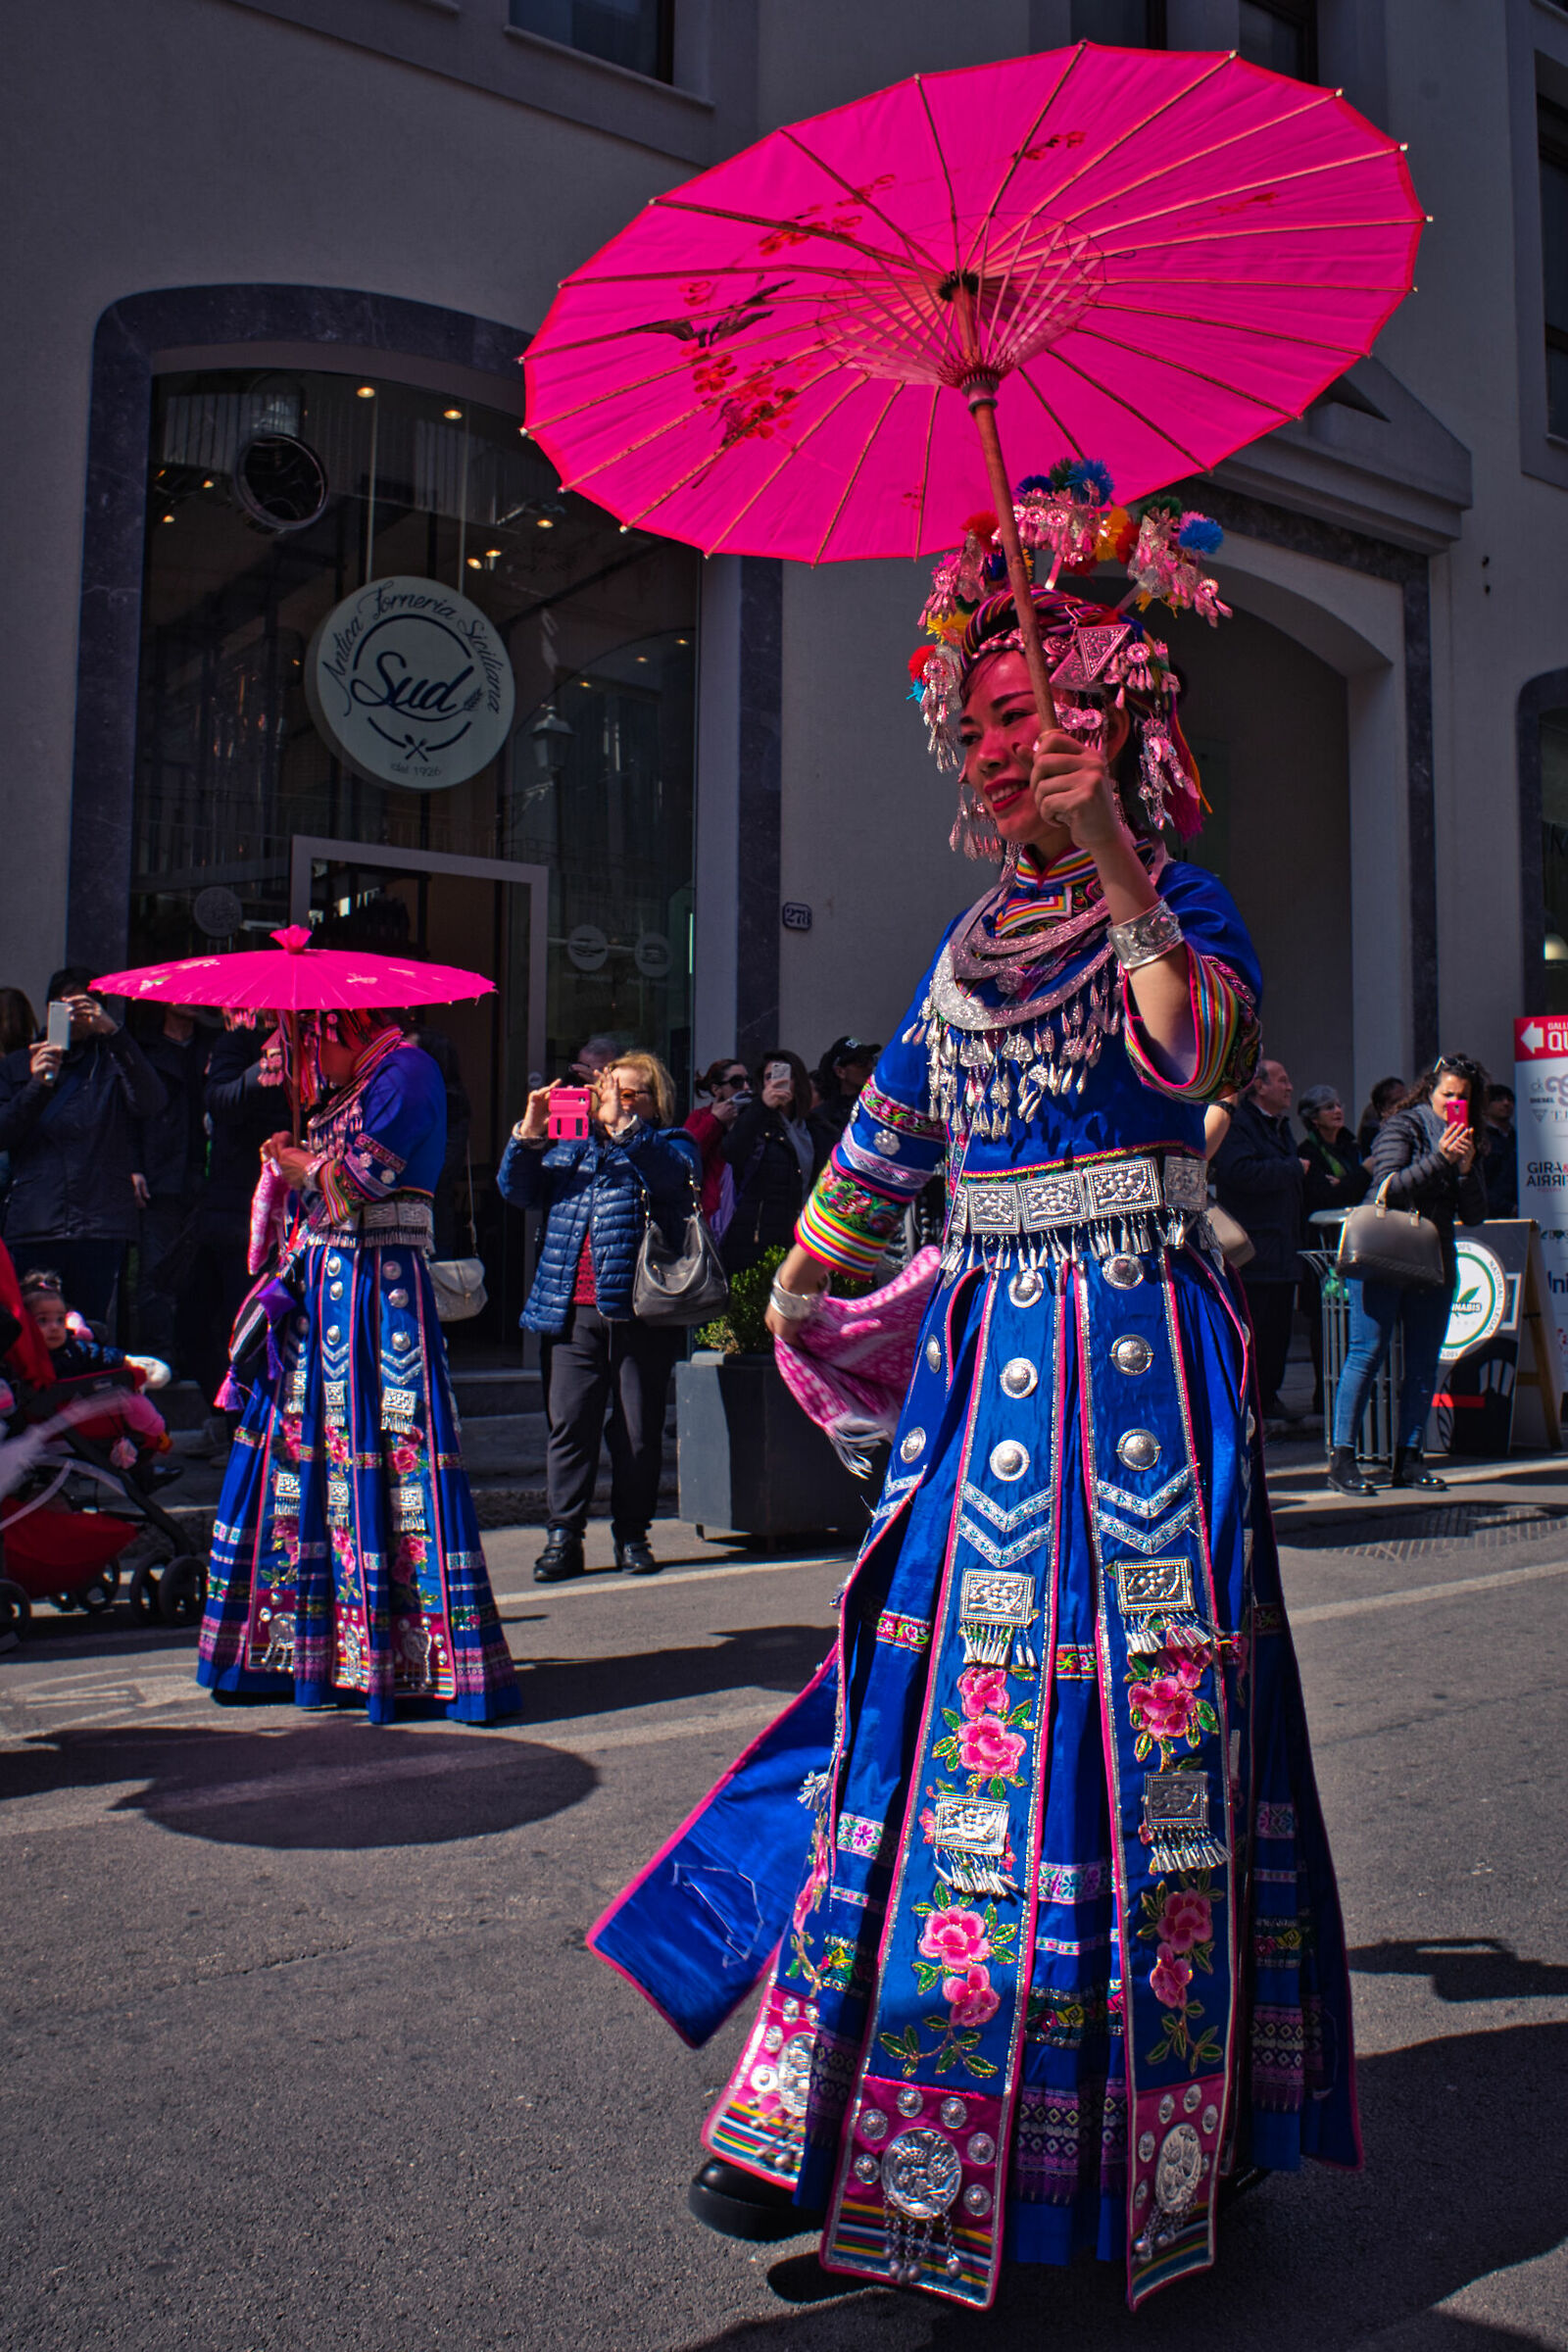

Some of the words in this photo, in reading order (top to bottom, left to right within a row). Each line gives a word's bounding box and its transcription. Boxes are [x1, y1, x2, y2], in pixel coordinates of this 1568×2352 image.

[321, 617, 365, 717] Antica
[358, 580, 457, 621] Forneria
[457, 618, 505, 714] Siciliana
[350, 651, 475, 713] Sud
[414, 764, 442, 777] 1926
[1547, 1021, 1568, 1031] GALL
[1489, 1259, 1505, 1299] NATURAL
[1484, 1306, 1502, 1336] LEGAL
